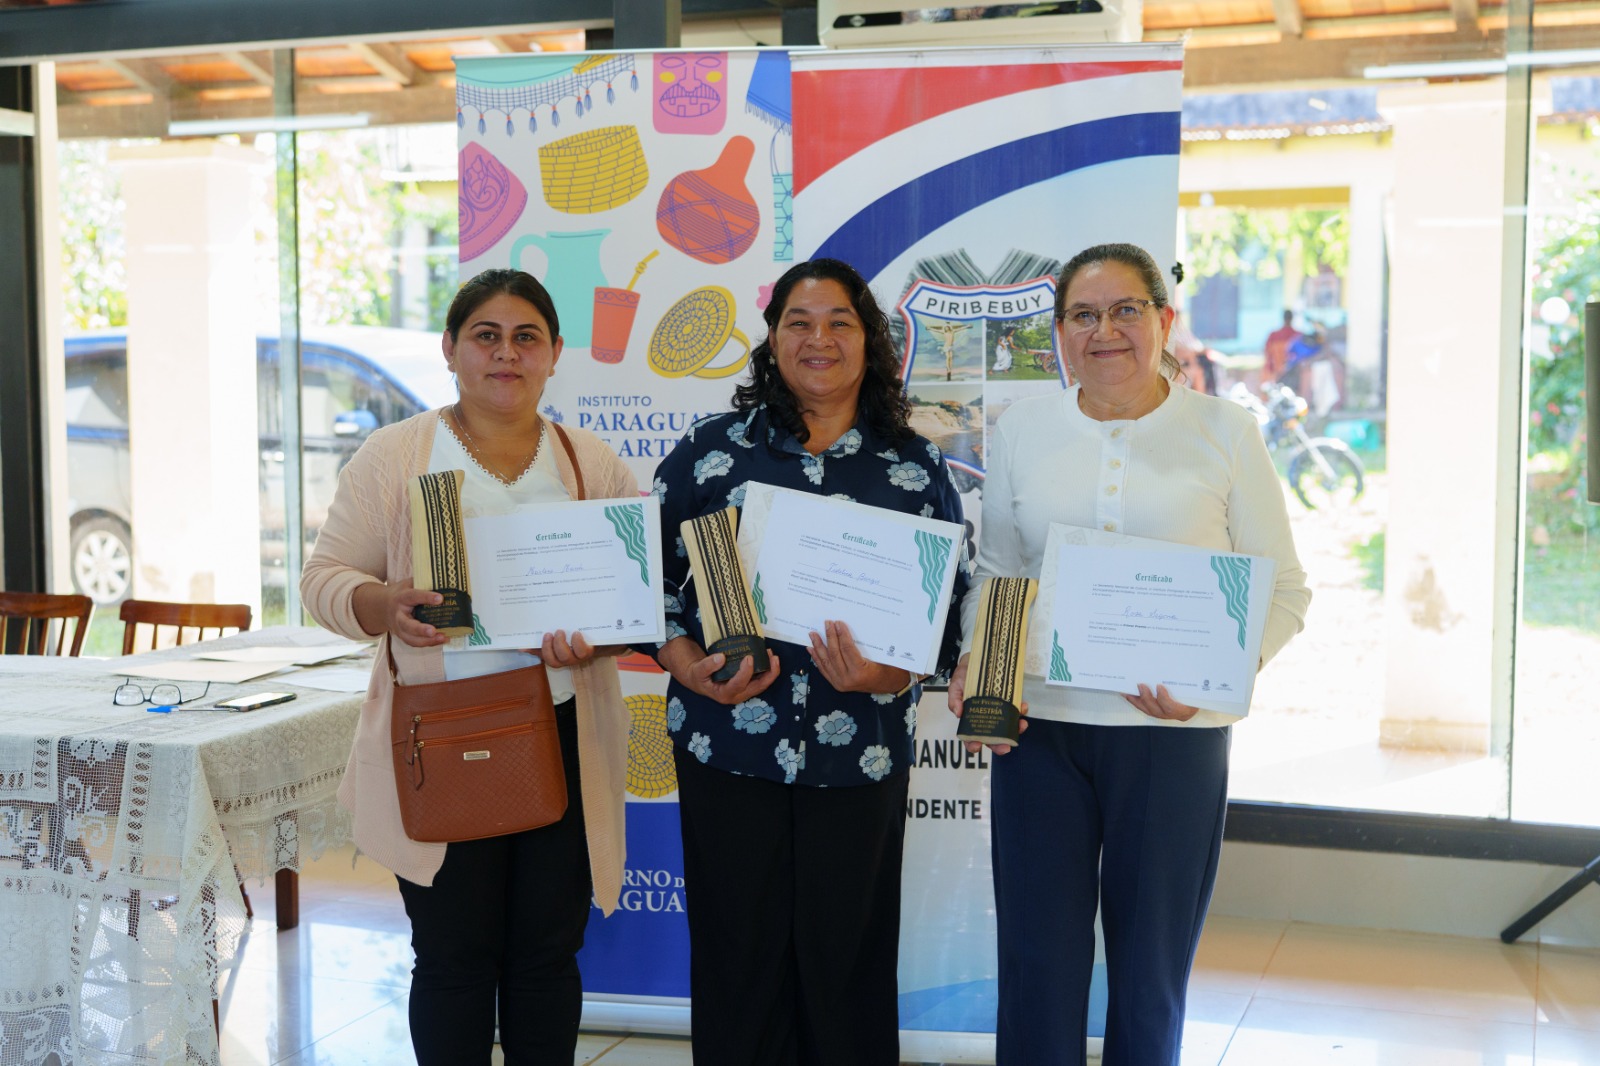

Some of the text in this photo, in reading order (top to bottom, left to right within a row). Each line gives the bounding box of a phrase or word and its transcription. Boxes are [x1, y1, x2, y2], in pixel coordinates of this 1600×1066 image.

[926, 294, 1042, 315] PIRIBEBUY
[578, 396, 652, 407] INSTITUTO
[535, 532, 572, 541] Certificado
[842, 532, 878, 549] Certificado
[1135, 573, 1173, 583] Certificado
